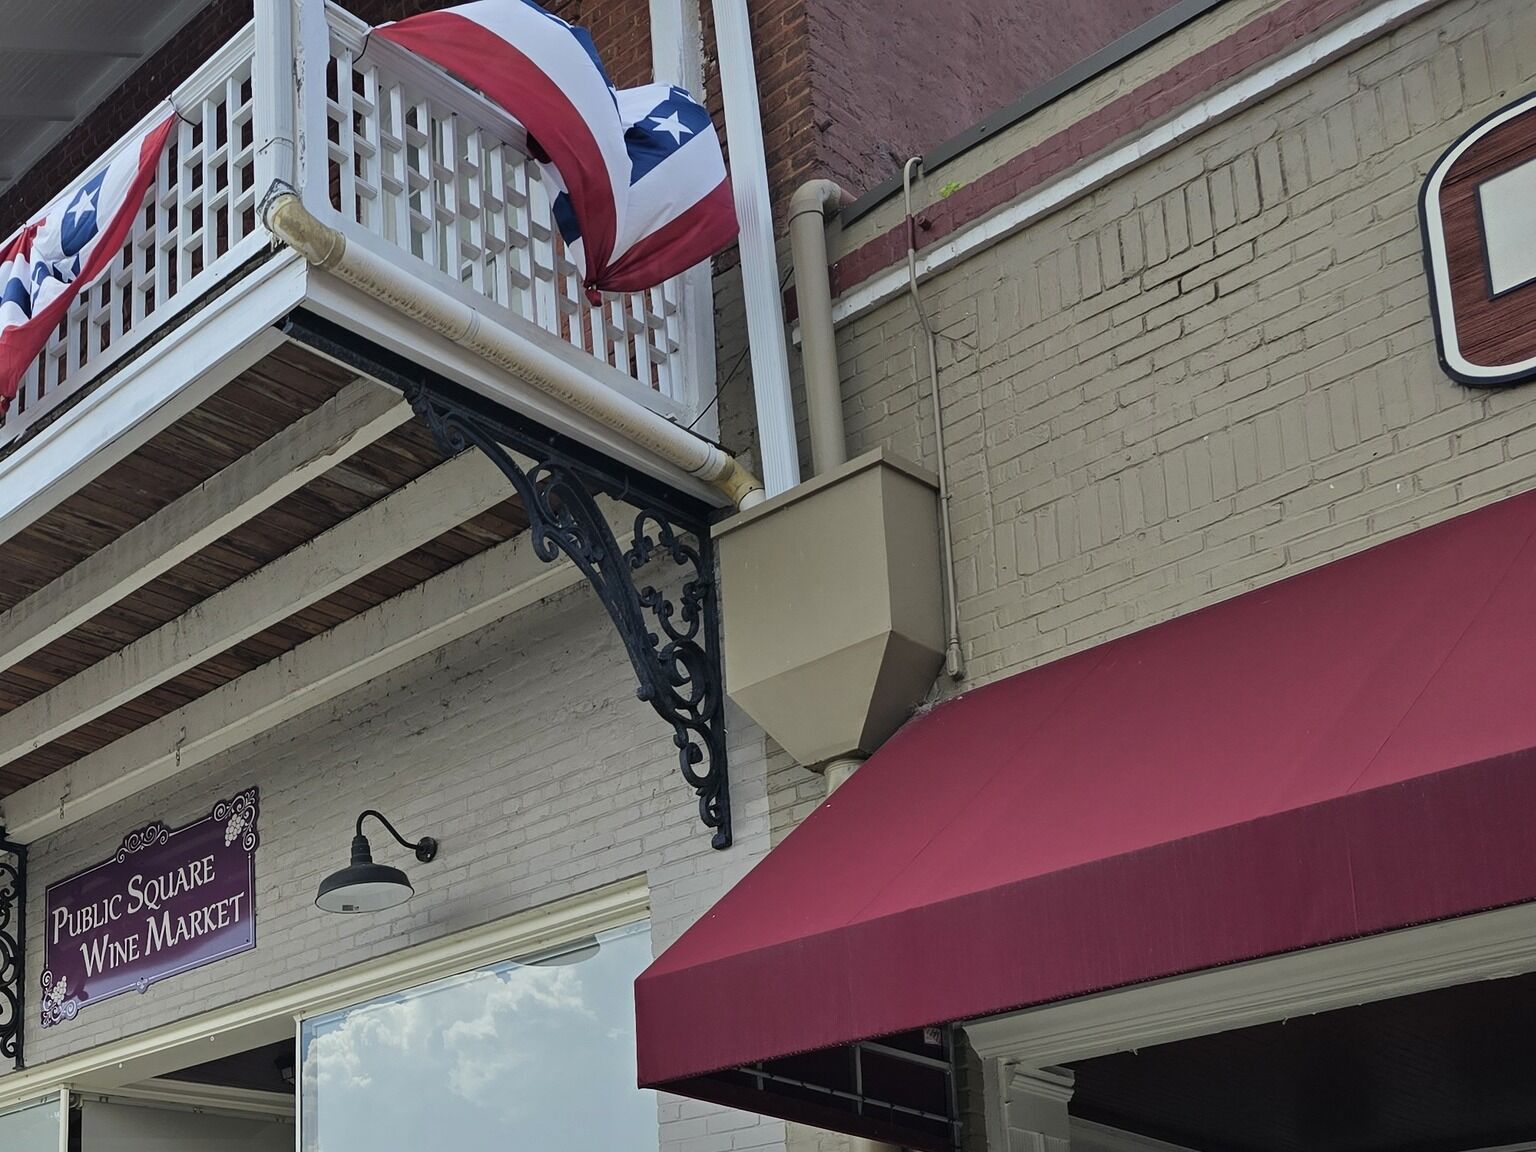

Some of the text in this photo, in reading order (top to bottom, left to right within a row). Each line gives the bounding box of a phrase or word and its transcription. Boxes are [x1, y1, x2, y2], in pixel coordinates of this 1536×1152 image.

[51, 854, 216, 945] PUBLIC SQUARE
[80, 891, 245, 978] WINE MARKET
